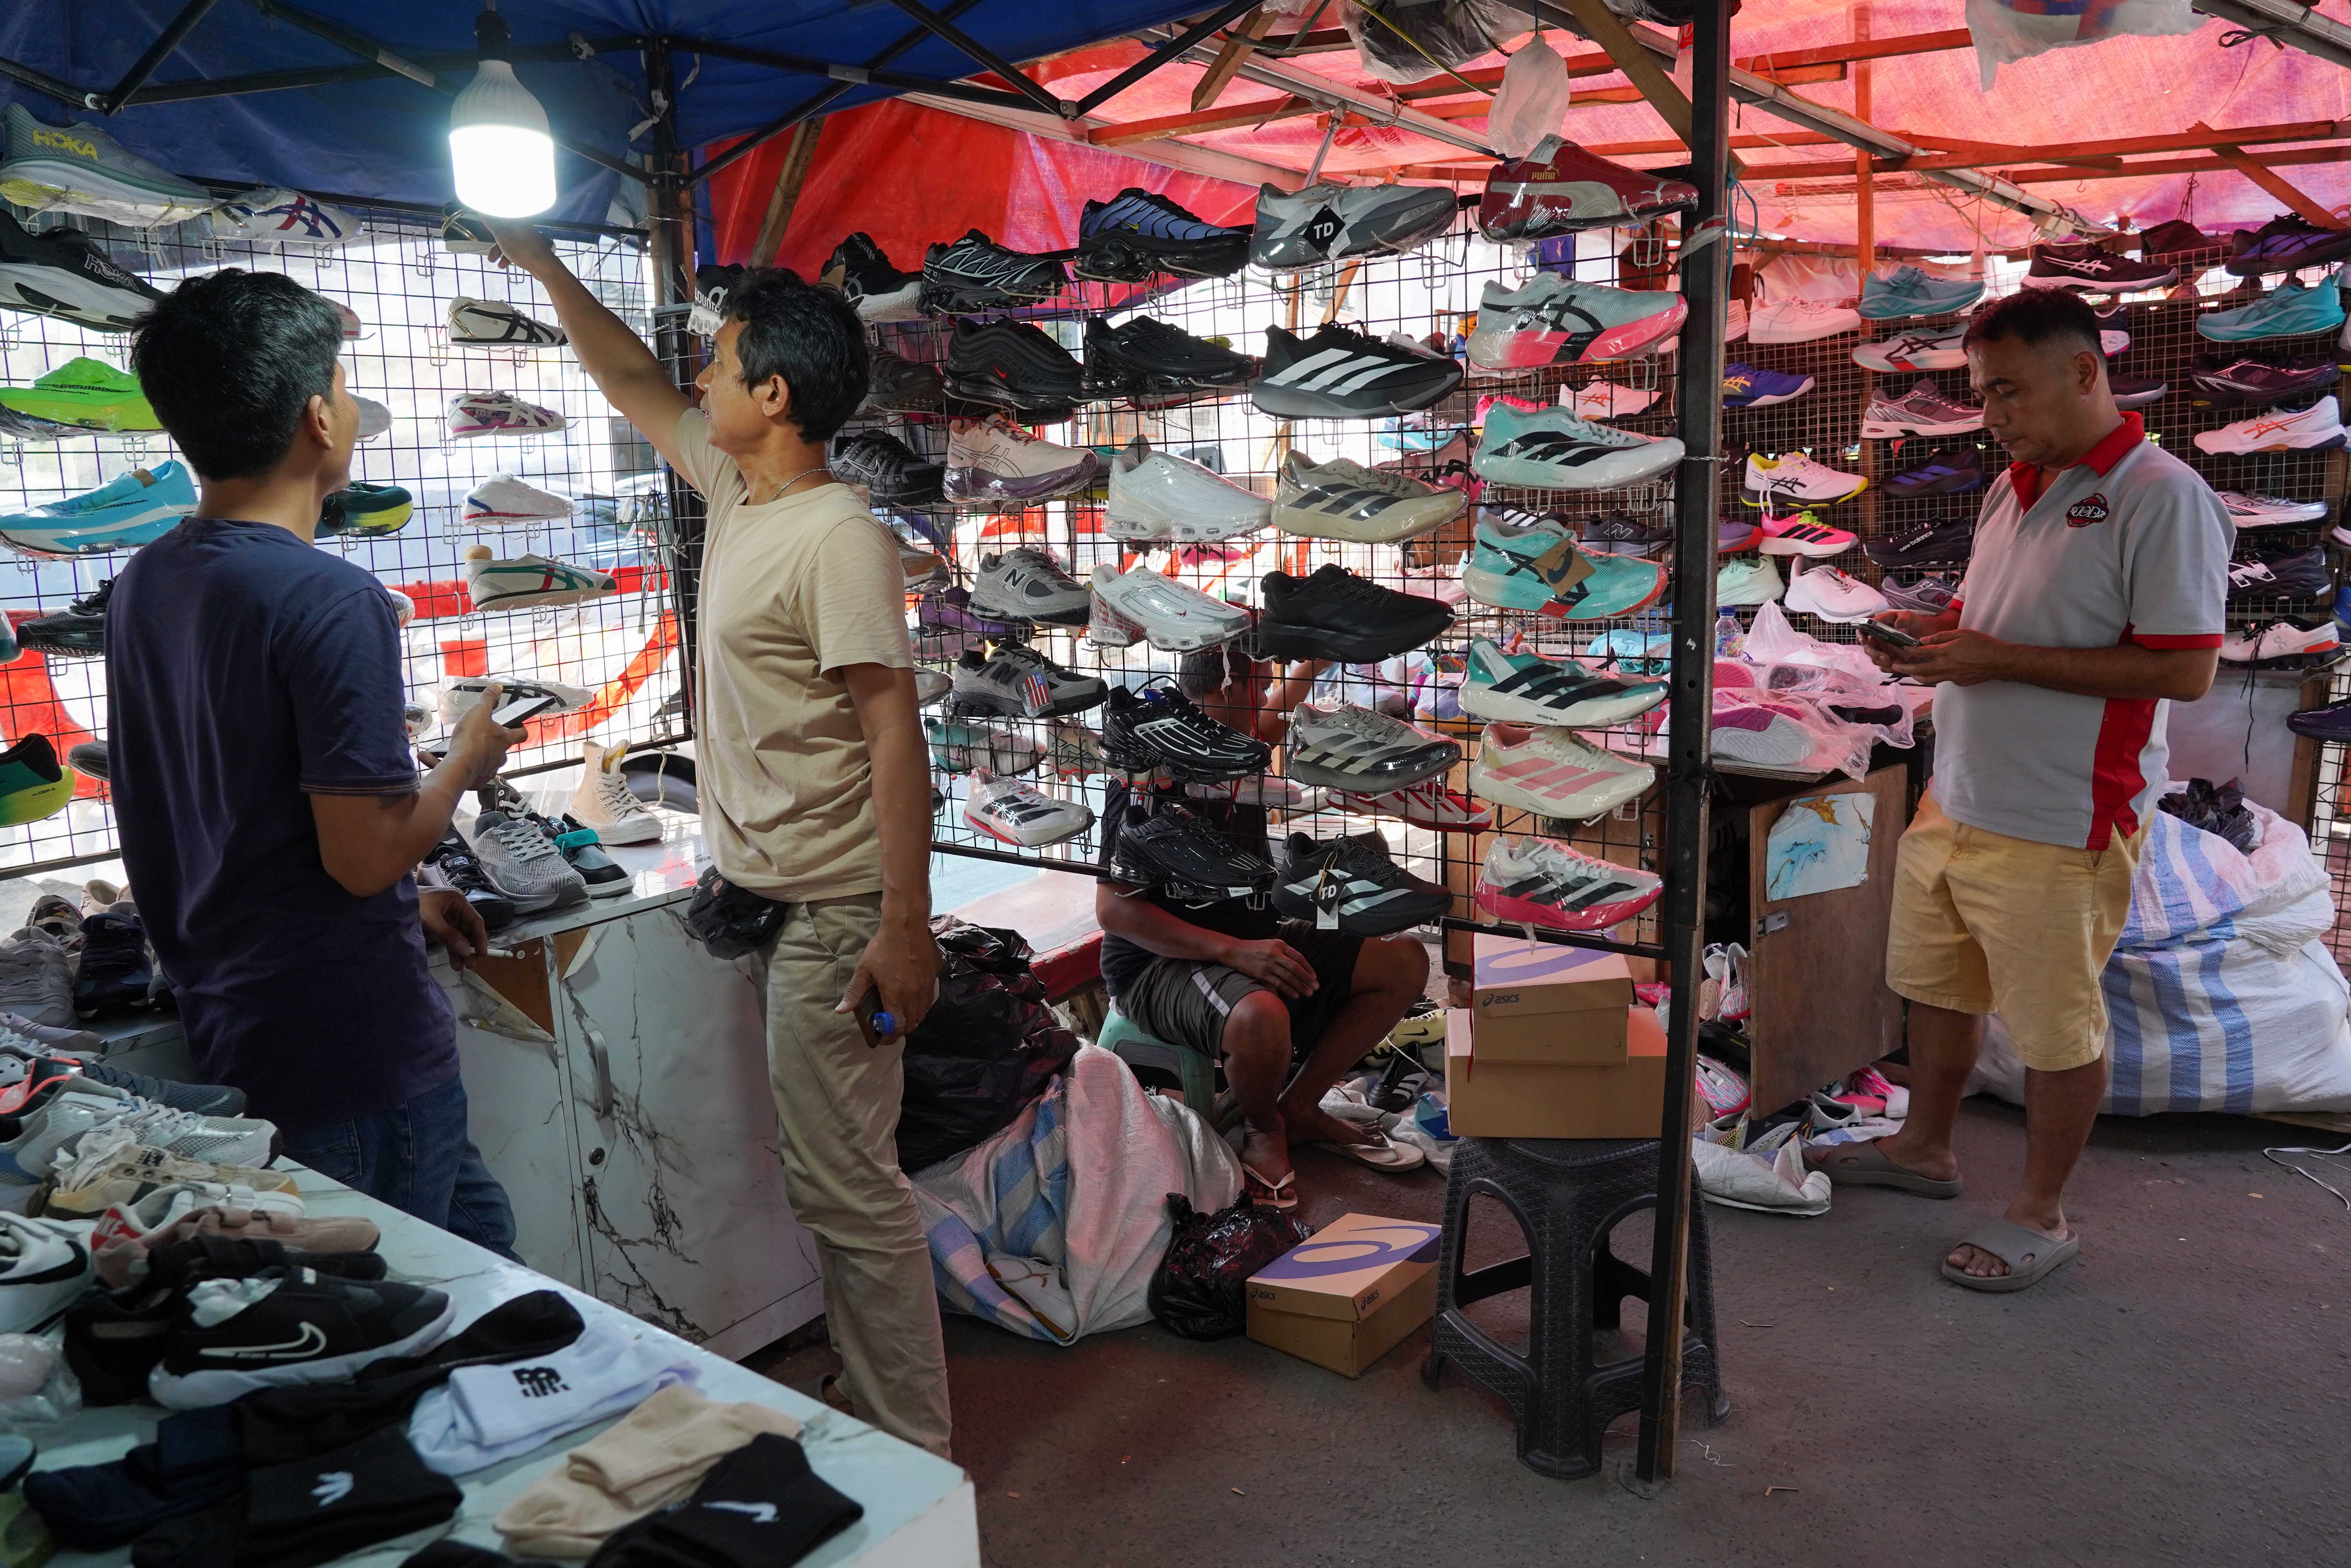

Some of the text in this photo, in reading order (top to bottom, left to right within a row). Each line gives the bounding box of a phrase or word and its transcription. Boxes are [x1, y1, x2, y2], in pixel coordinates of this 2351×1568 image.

[32, 129, 98, 162] HOKA
[1314, 222, 1333, 239] TD
[85, 253, 140, 292] HOKA
[1899, 531, 1933, 552] new balance
[1002, 566, 1028, 589] N
[1322, 884, 1337, 900] TD
[1494, 994, 1520, 1004] asics
[1258, 1291, 1276, 1300] asics
[1367, 1290, 1379, 1305] asics
